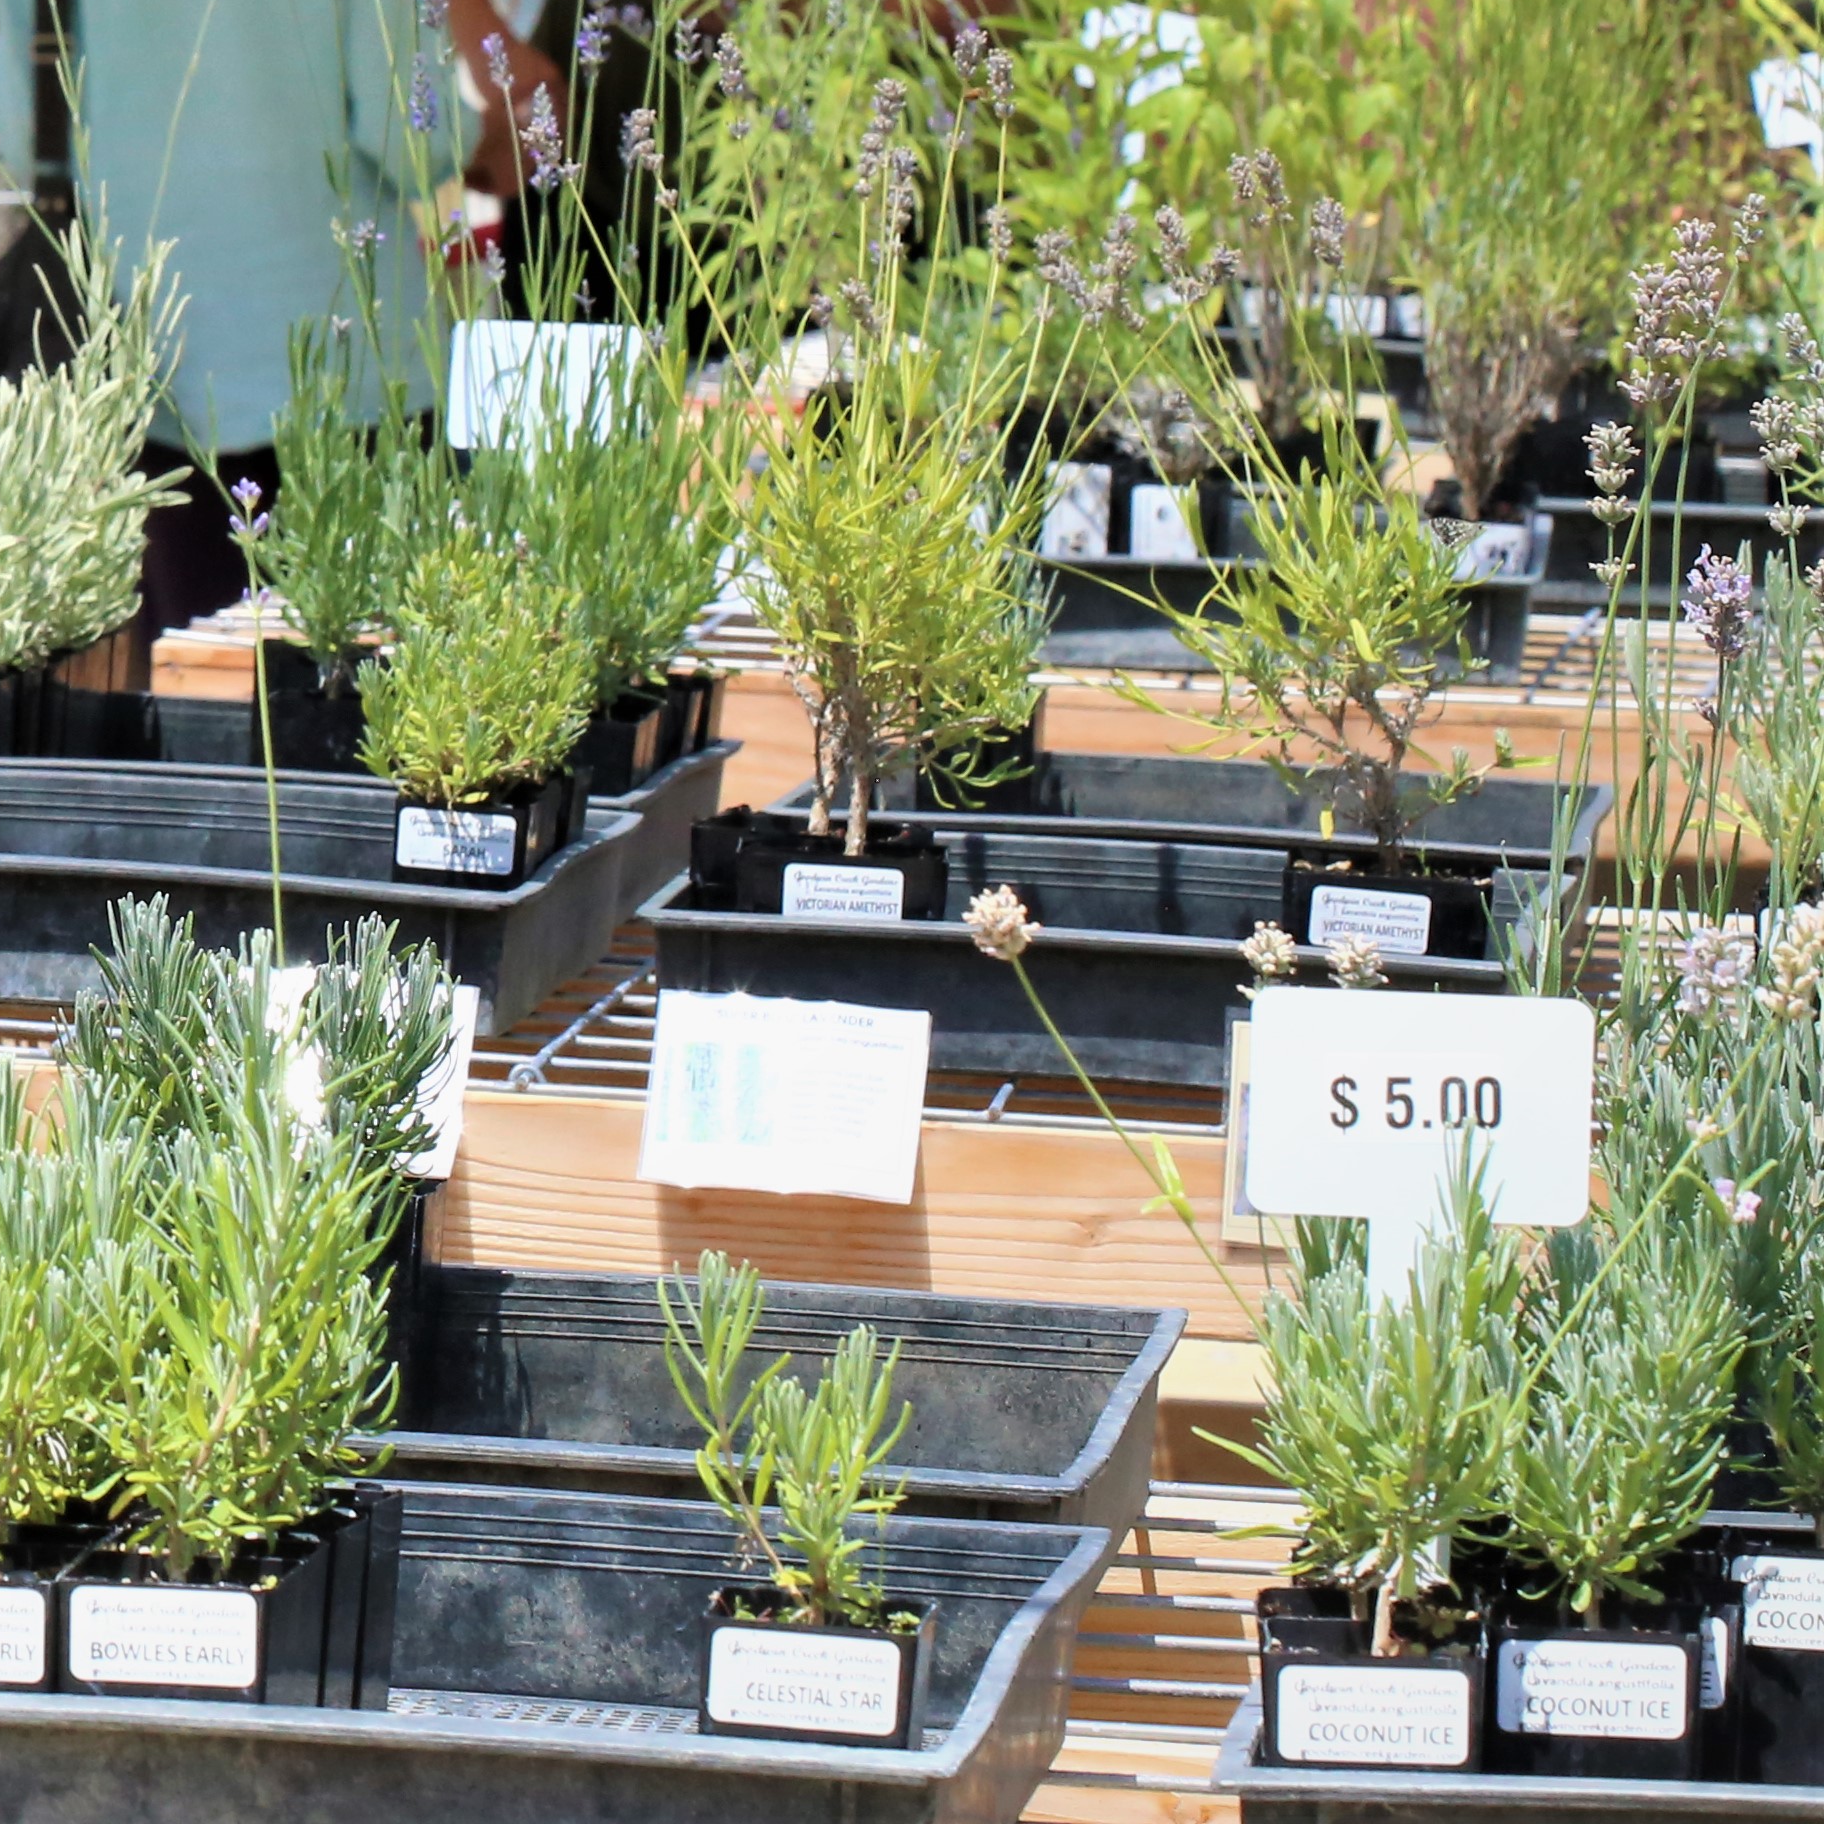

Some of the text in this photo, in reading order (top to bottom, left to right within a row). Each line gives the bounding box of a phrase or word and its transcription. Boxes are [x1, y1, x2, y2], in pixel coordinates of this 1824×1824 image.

[796, 898, 899, 915] VICTORIAN AMETHYST
[1323, 920, 1425, 940] VICTORIAN AMETHYST
[802, 1012, 875, 1028] LANDER
[1329, 1075, 1503, 1135] $ 5.00
[1757, 1590, 1822, 1602] Lavandula
[90, 1641, 248, 1665] BOWLES EARLY
[1527, 1674, 1594, 1687] Lavandula
[745, 1681, 883, 1710] CELESTIAL STAR
[1526, 1695, 1671, 1719] COCONUT ICE
[1308, 1723, 1455, 1745] COCONUT ICE
